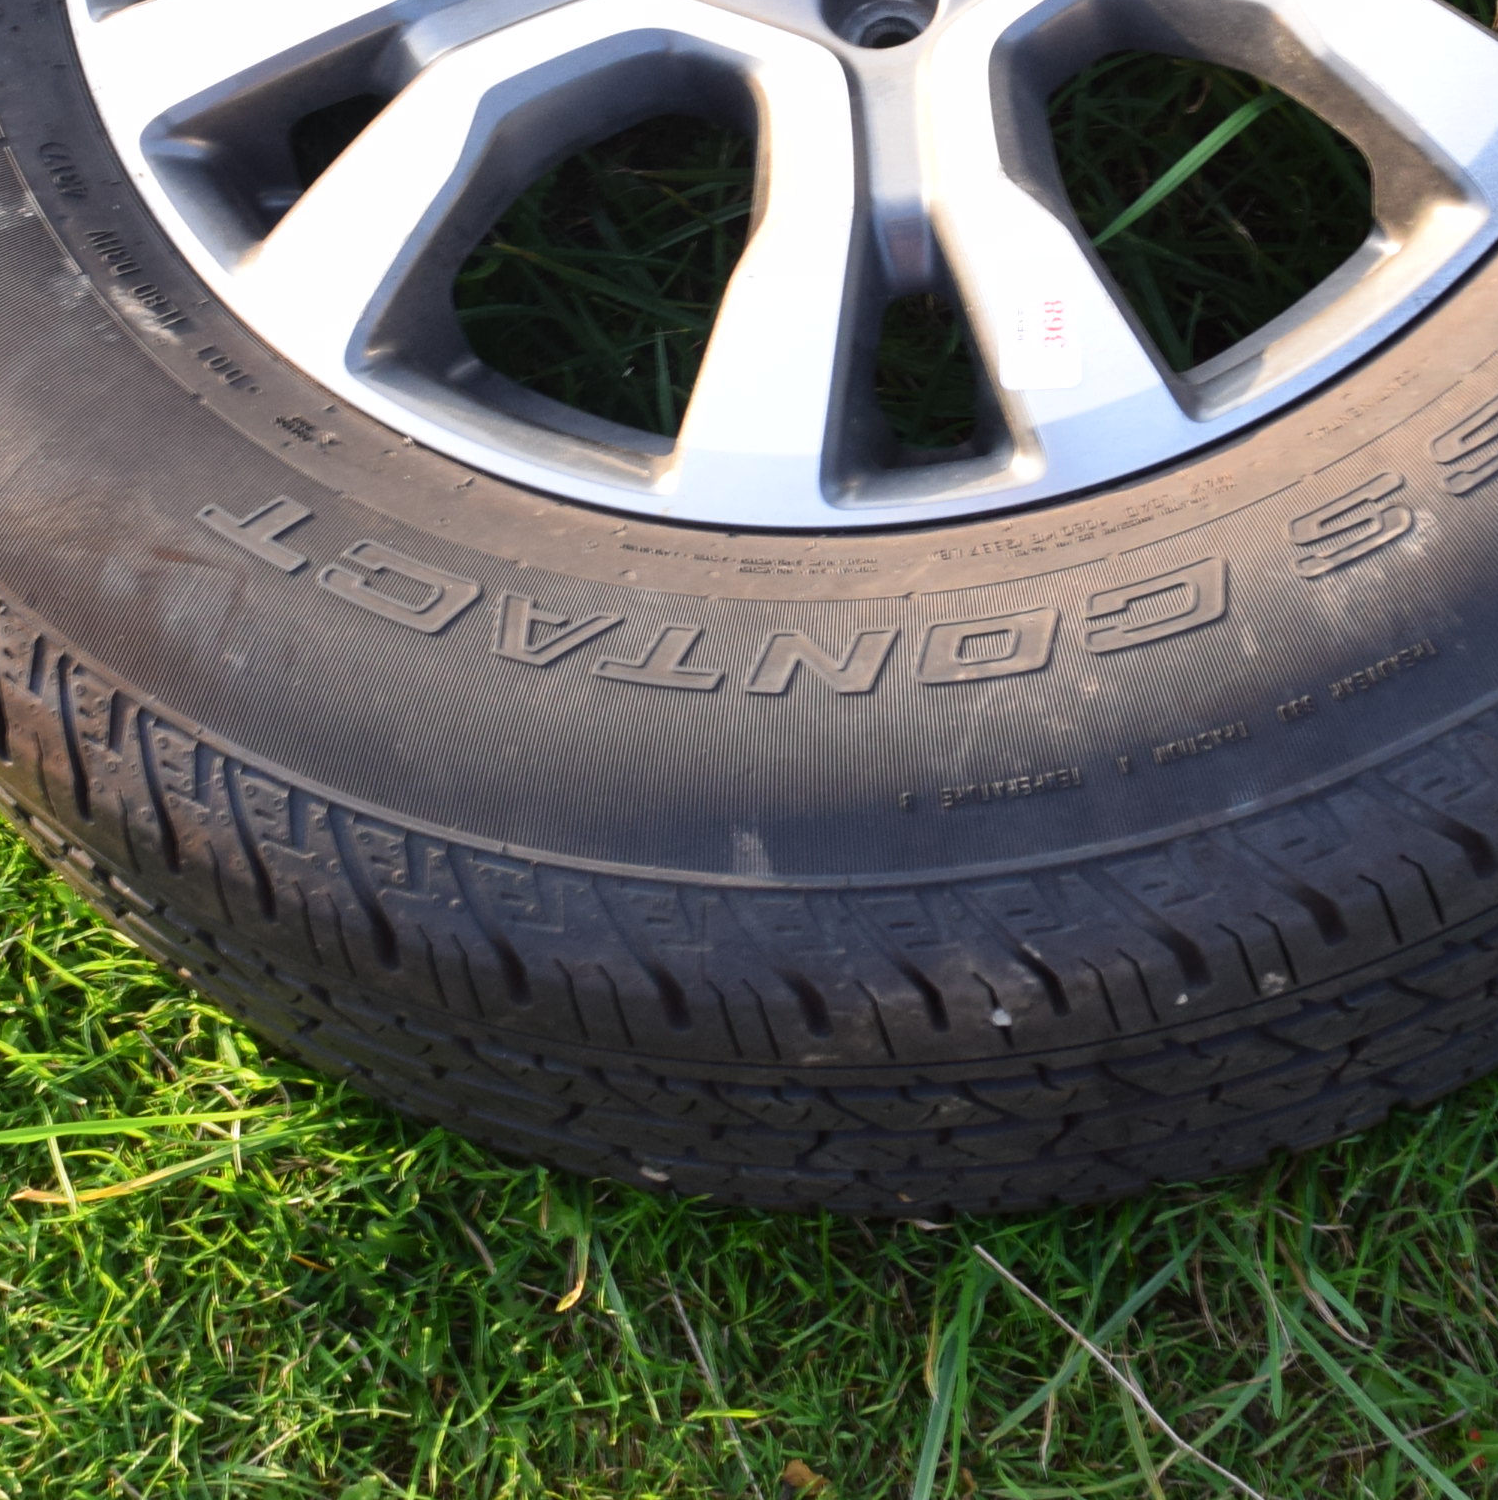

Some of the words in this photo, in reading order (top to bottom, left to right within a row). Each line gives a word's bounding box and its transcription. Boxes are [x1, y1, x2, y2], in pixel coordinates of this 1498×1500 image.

[1043, 299, 1068, 349] 368
[197, 343, 249, 386] DOT
[195, 491, 1230, 696] CONTACT
[1152, 719, 1250, 765] TRACTION
[939, 766, 1082, 809] TEMPERATURE
